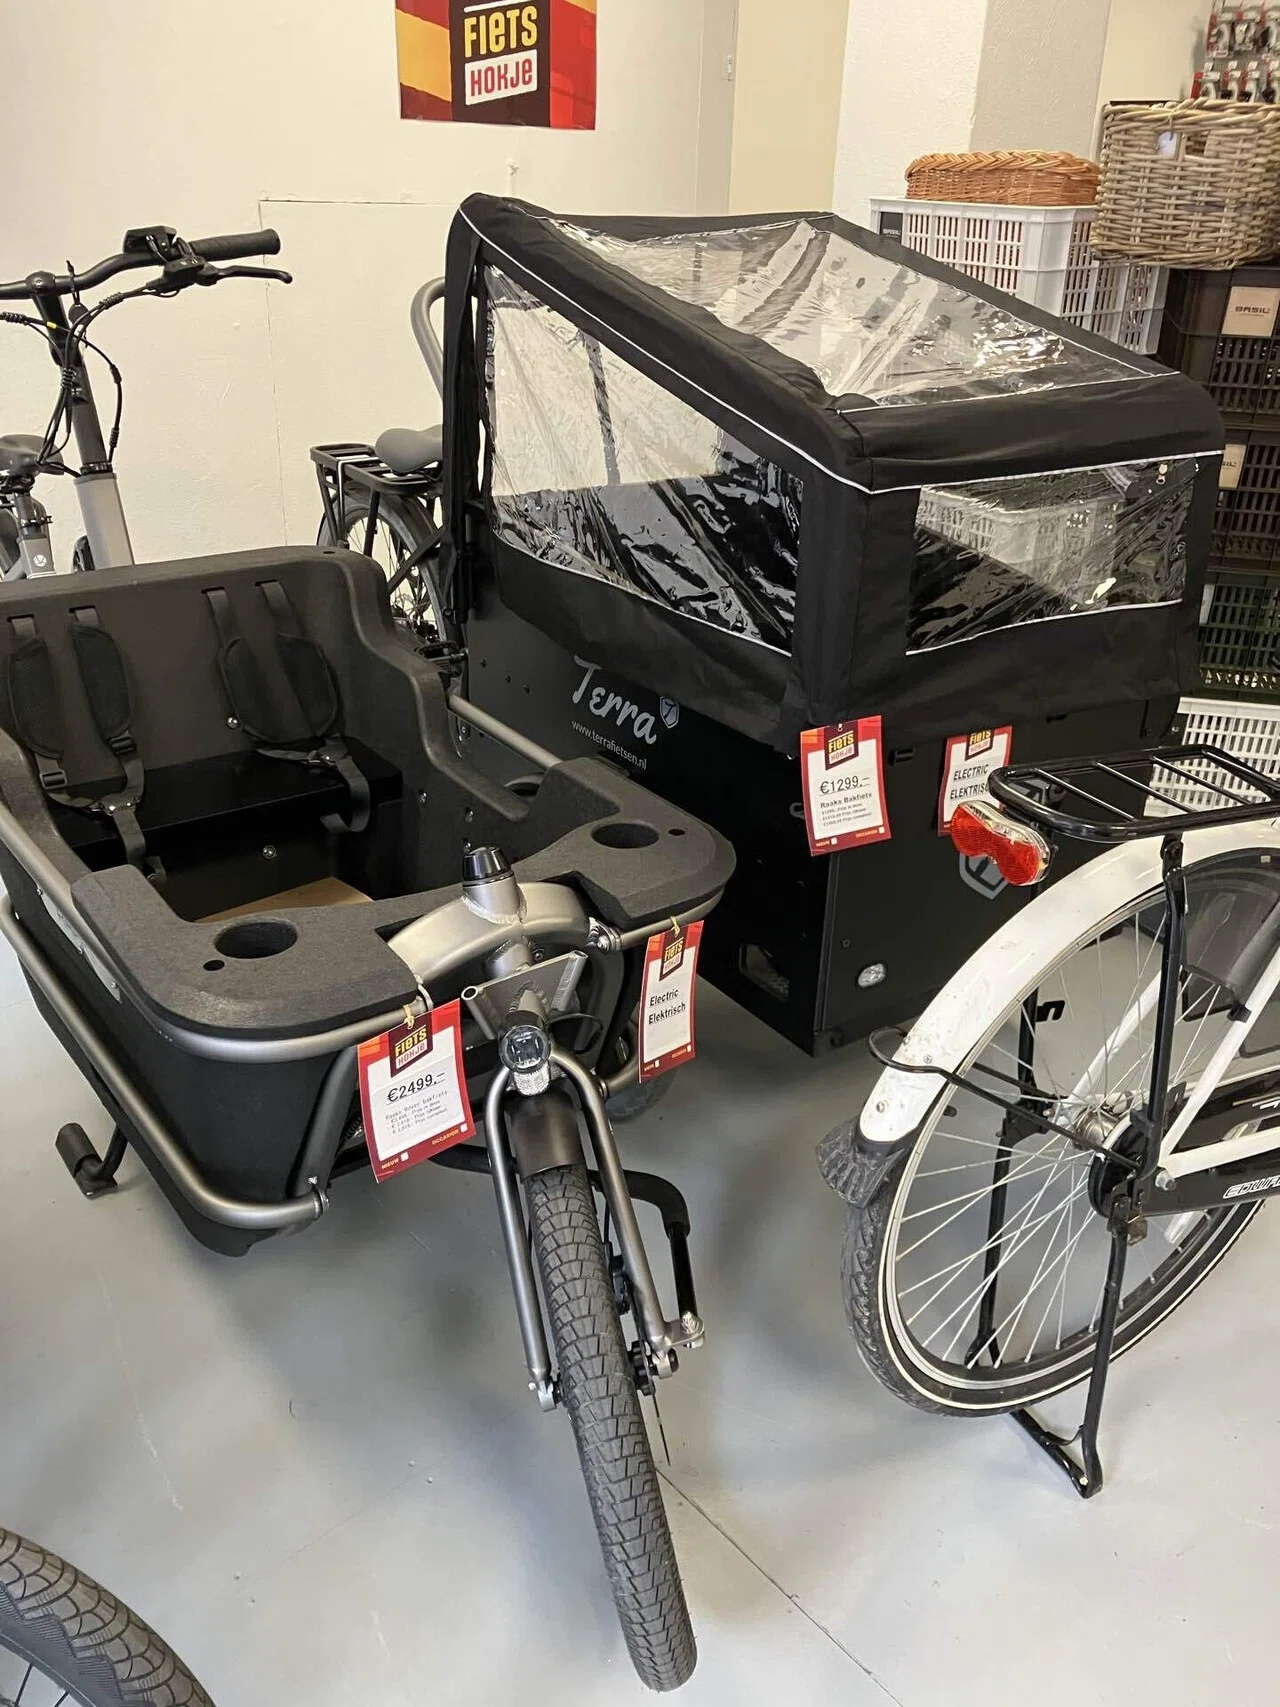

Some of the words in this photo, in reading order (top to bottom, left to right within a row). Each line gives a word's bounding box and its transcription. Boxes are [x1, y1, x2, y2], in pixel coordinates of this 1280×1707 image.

[572, 654, 657, 745] Terra
[571, 720, 647, 771] www.terrafietsen.nl
[953, 764, 989, 781] ELECTRIC
[649, 988, 679, 1007] Electric
[648, 1001, 686, 1025] Elektrisch
